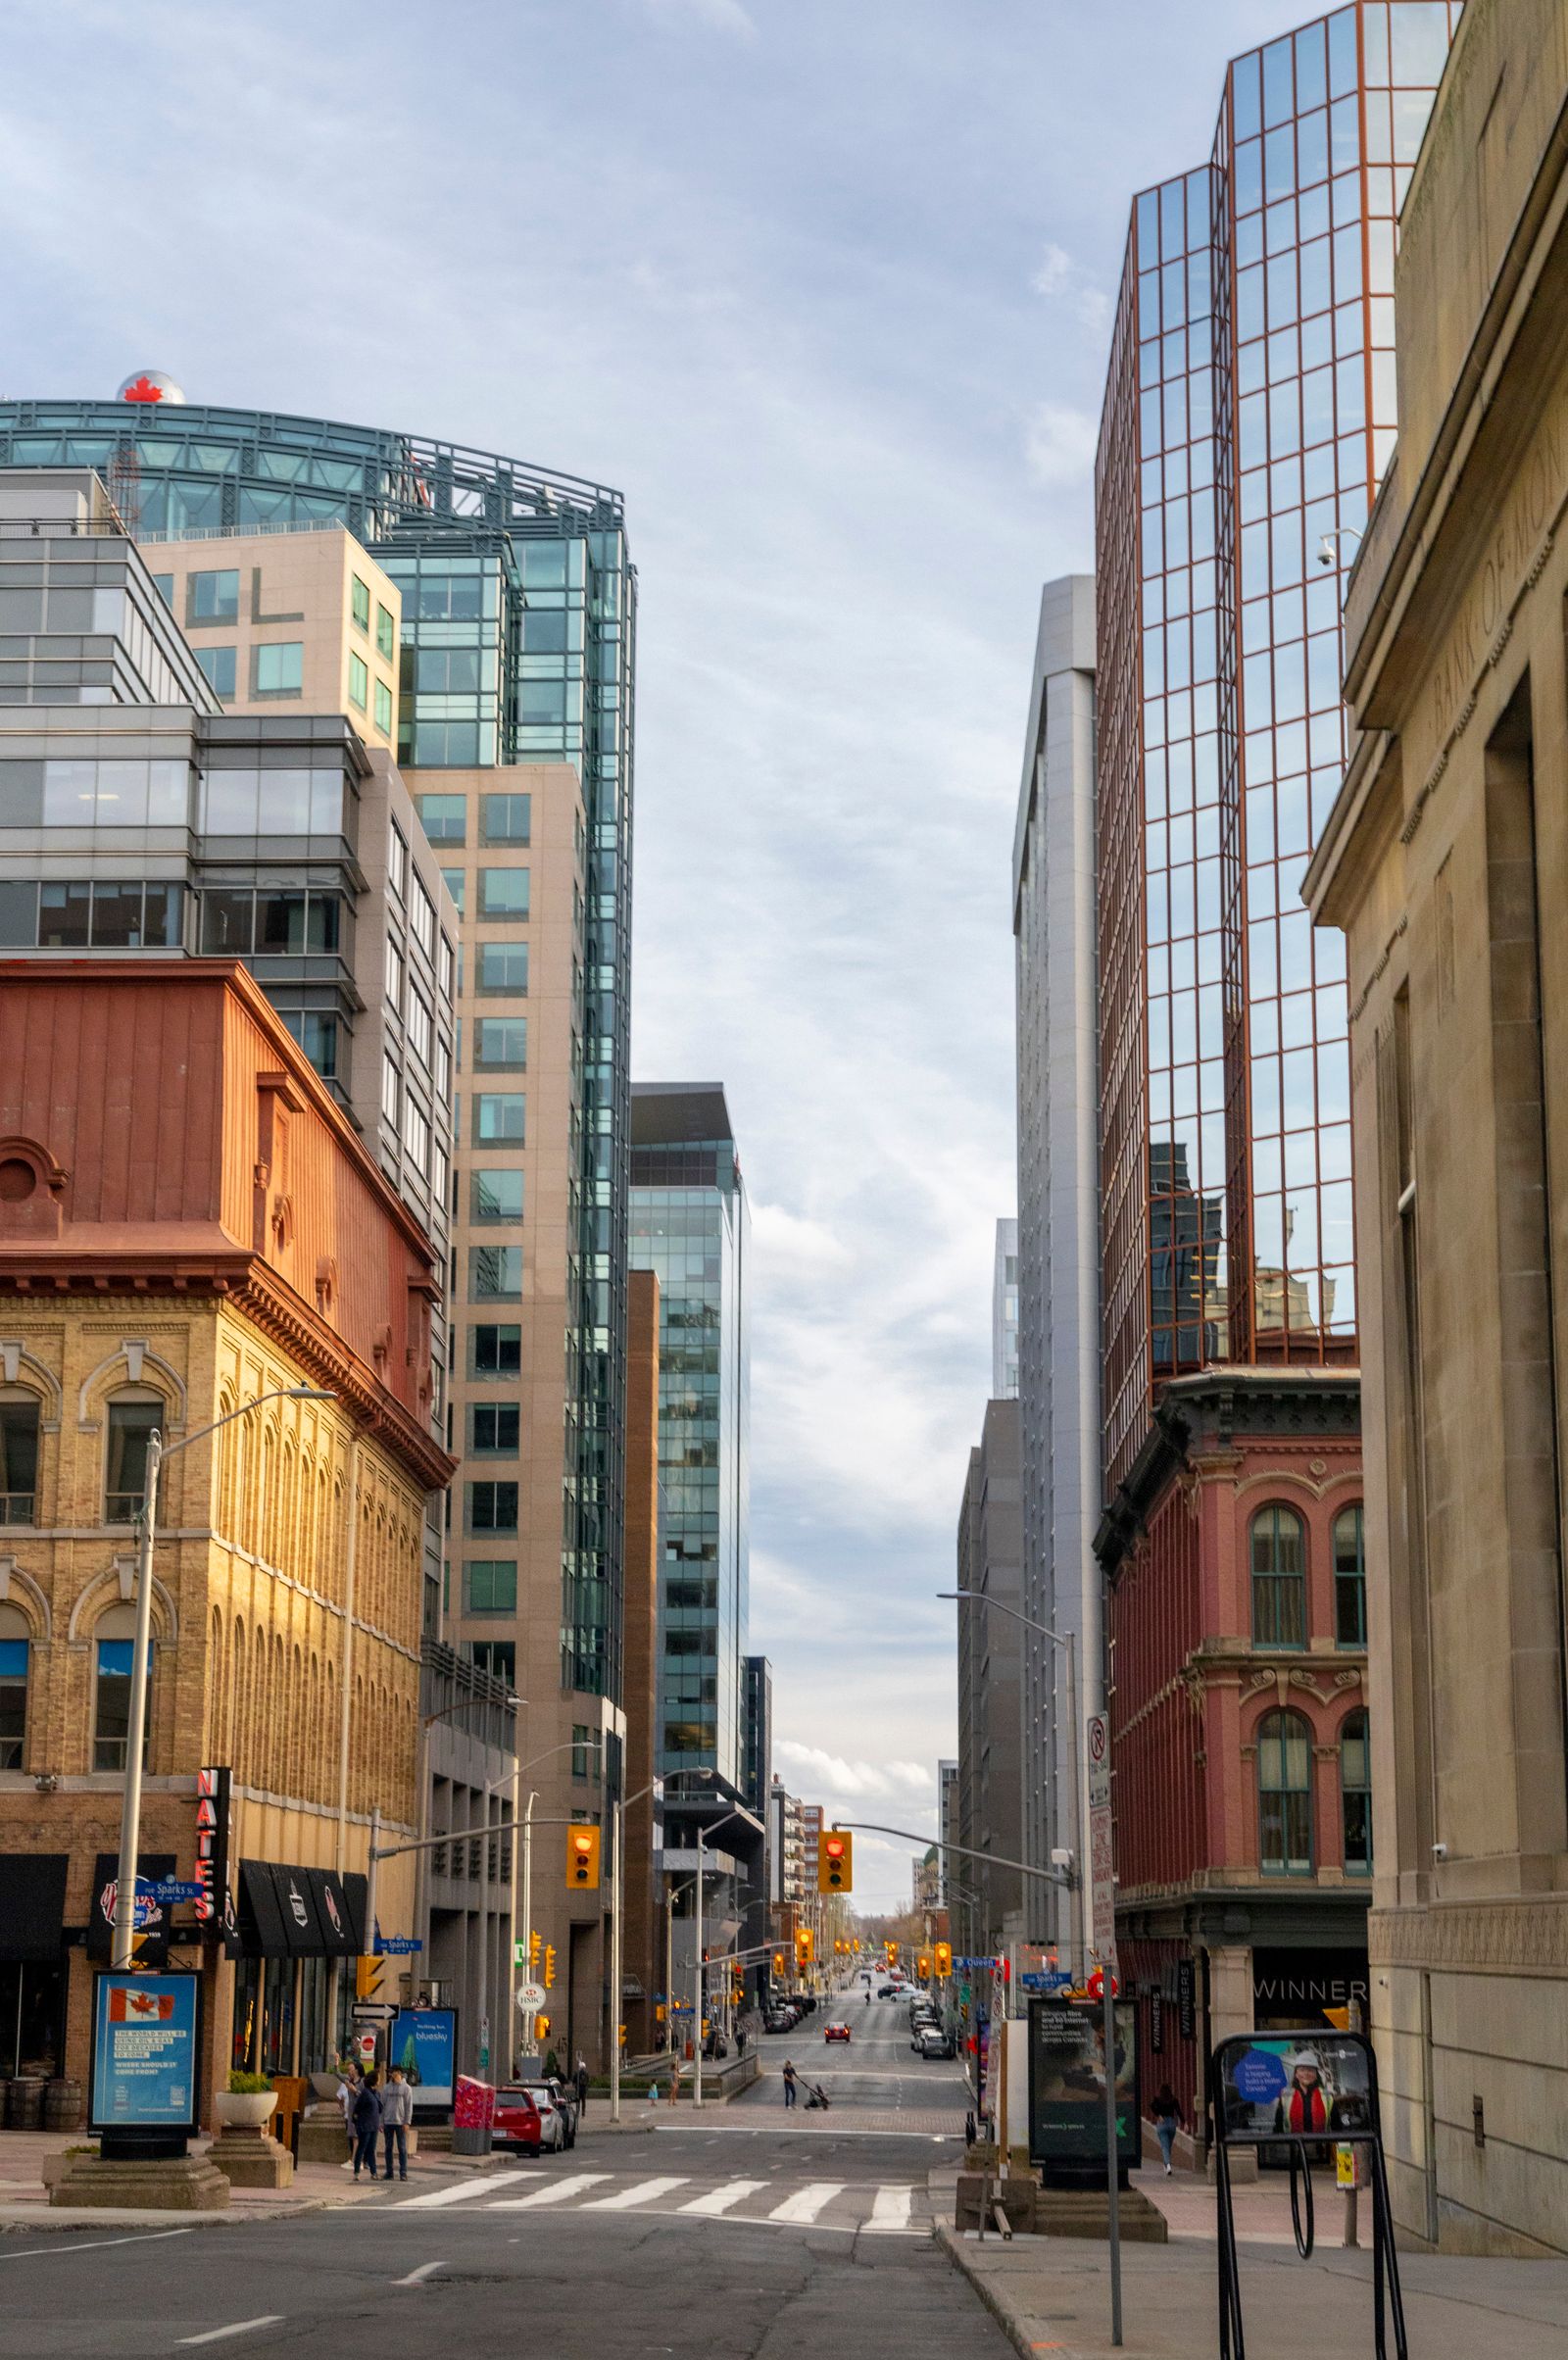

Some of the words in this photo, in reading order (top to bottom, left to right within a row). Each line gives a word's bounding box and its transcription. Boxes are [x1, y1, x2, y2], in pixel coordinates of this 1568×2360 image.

[157, 1883, 185, 1896] Sparks
[389, 1941, 409, 1949] Sparks
[1037, 1974, 1057, 1984] Sparks
[1180, 1967, 1190, 2035] WINNERS
[416, 2032, 448, 2042] bluesky
